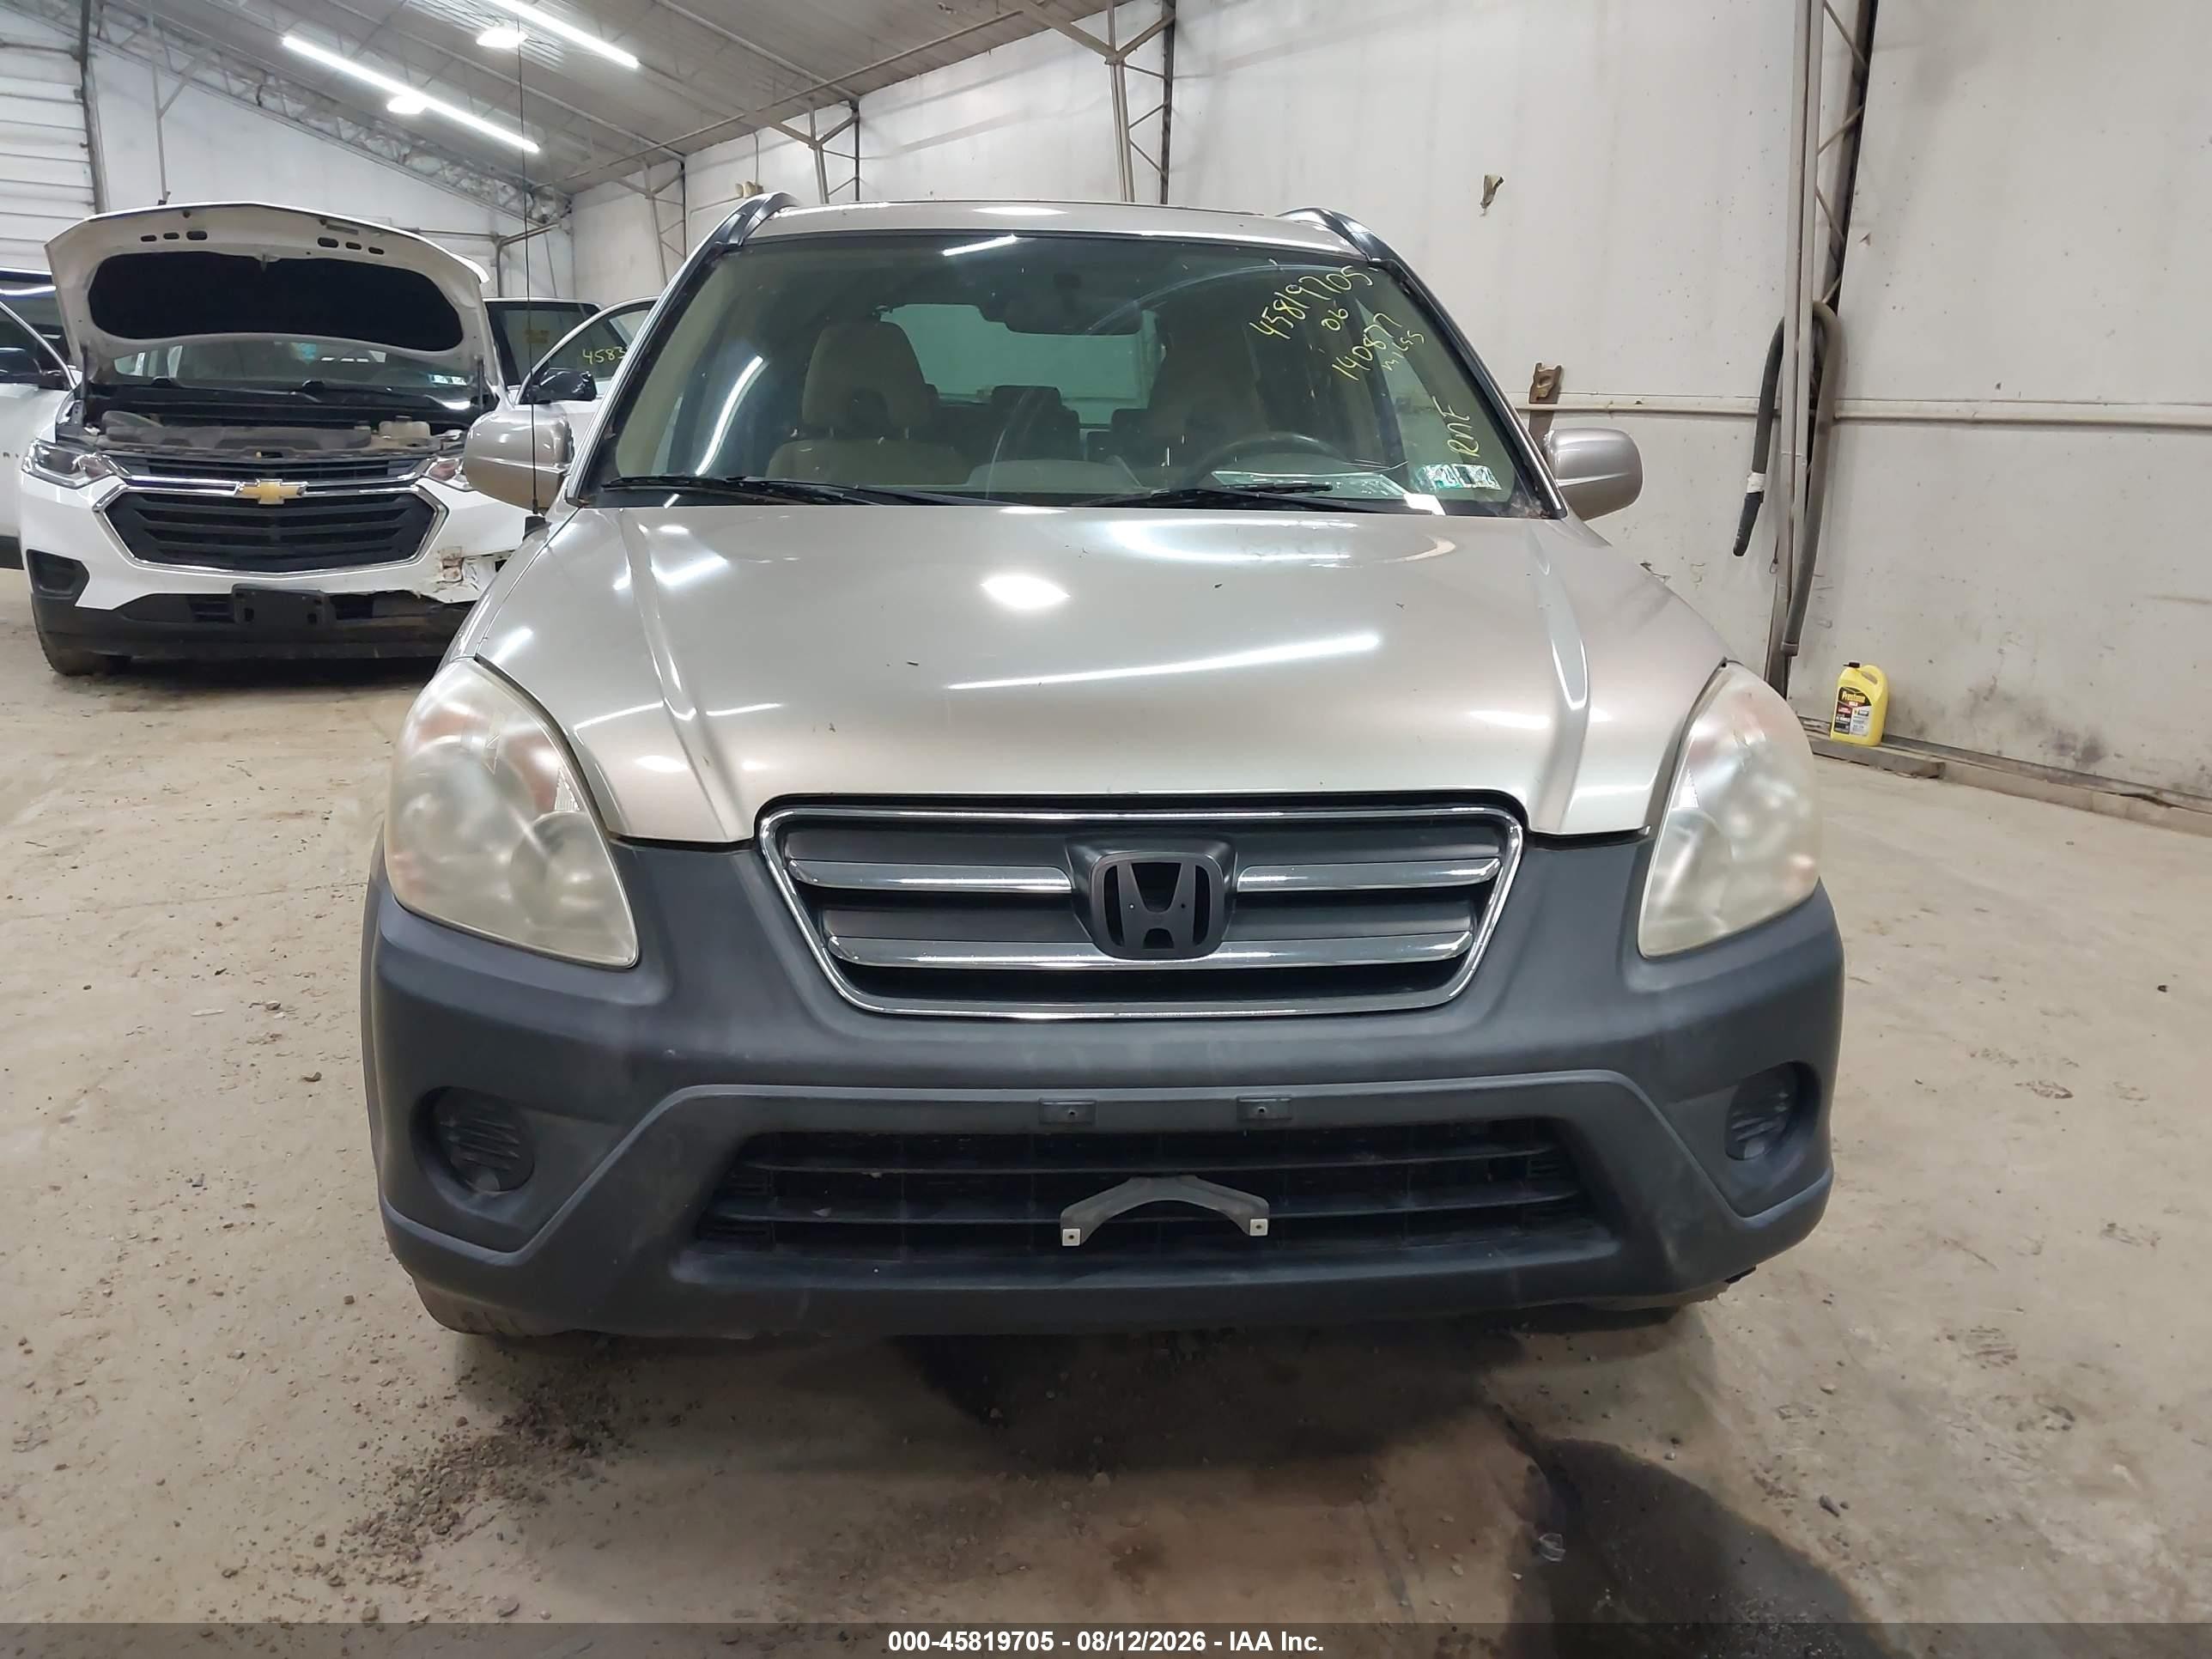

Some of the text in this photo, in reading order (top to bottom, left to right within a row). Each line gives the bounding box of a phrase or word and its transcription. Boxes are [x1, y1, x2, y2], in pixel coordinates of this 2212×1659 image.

[1249, 265, 1373, 339] 45819705
[1321, 307, 1349, 331] 06
[582, 346, 629, 365] 4583
